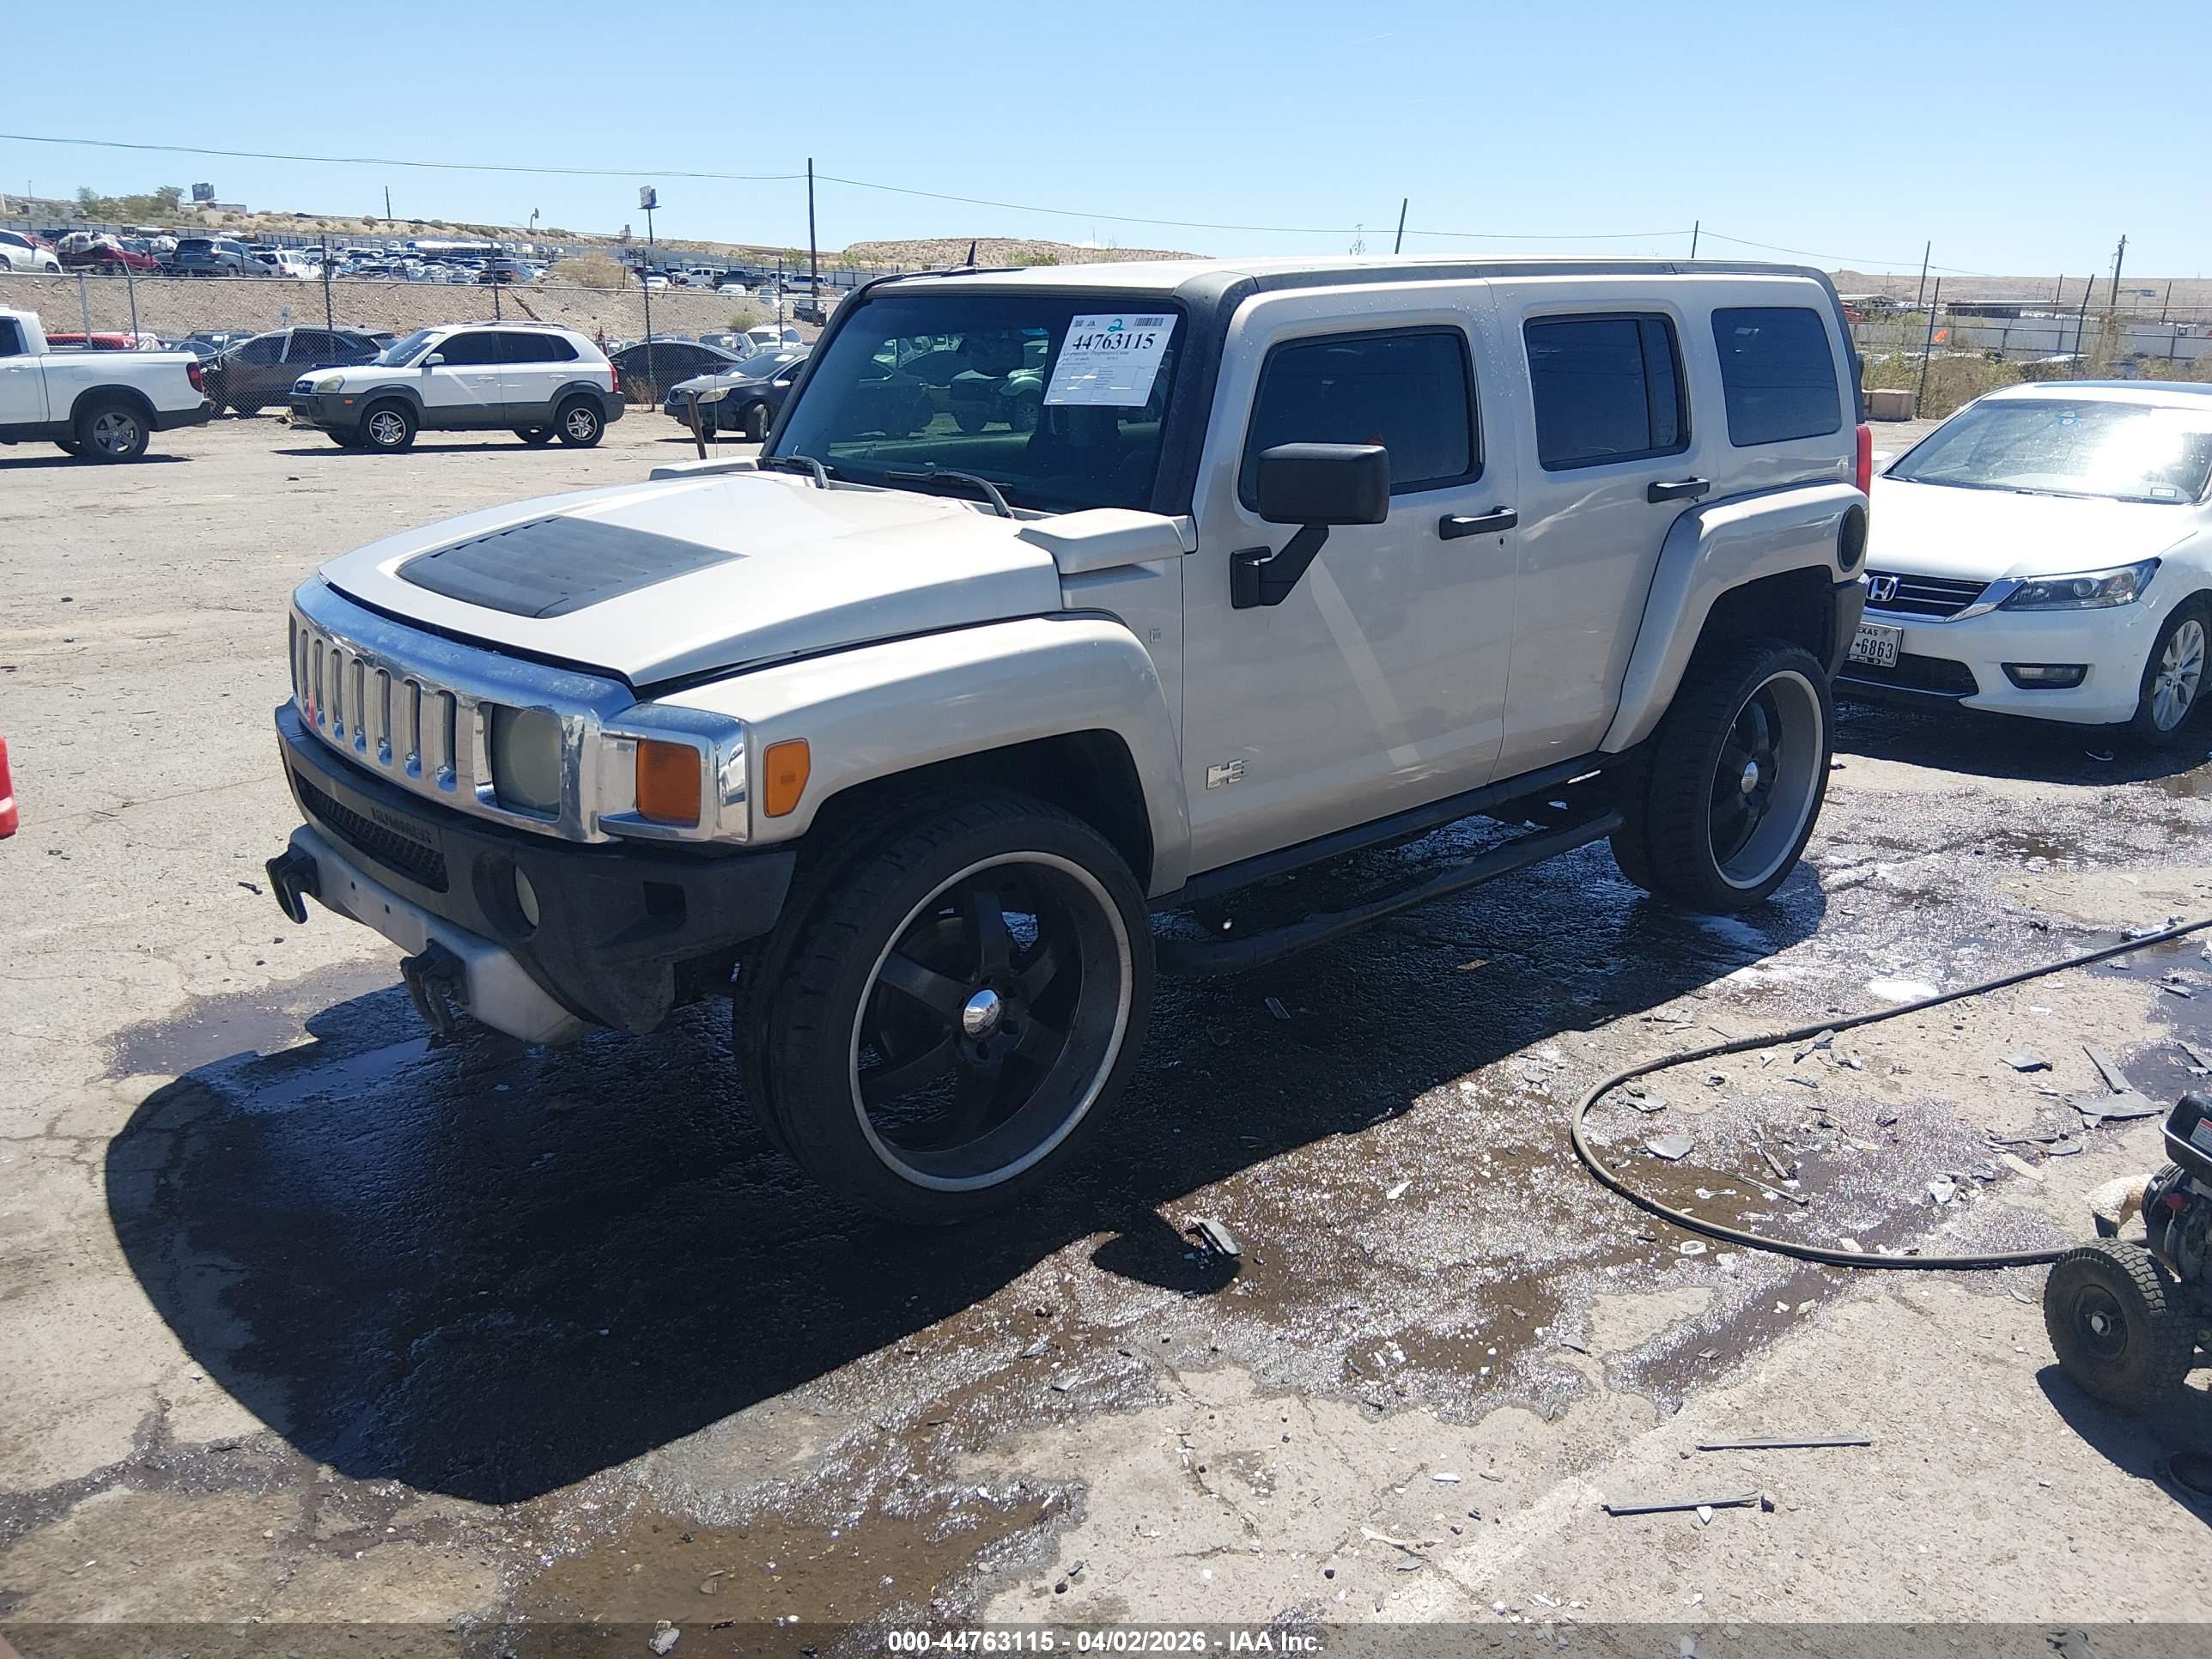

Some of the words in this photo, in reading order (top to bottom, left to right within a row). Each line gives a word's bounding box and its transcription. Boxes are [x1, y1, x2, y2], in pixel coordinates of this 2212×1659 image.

[1107, 318, 1126, 332] 2
[1073, 332, 1157, 350] 44763115
[1856, 626, 1878, 636] EXAS
[1861, 638, 1894, 659] 6863
[371, 807, 432, 844] HUMMER
